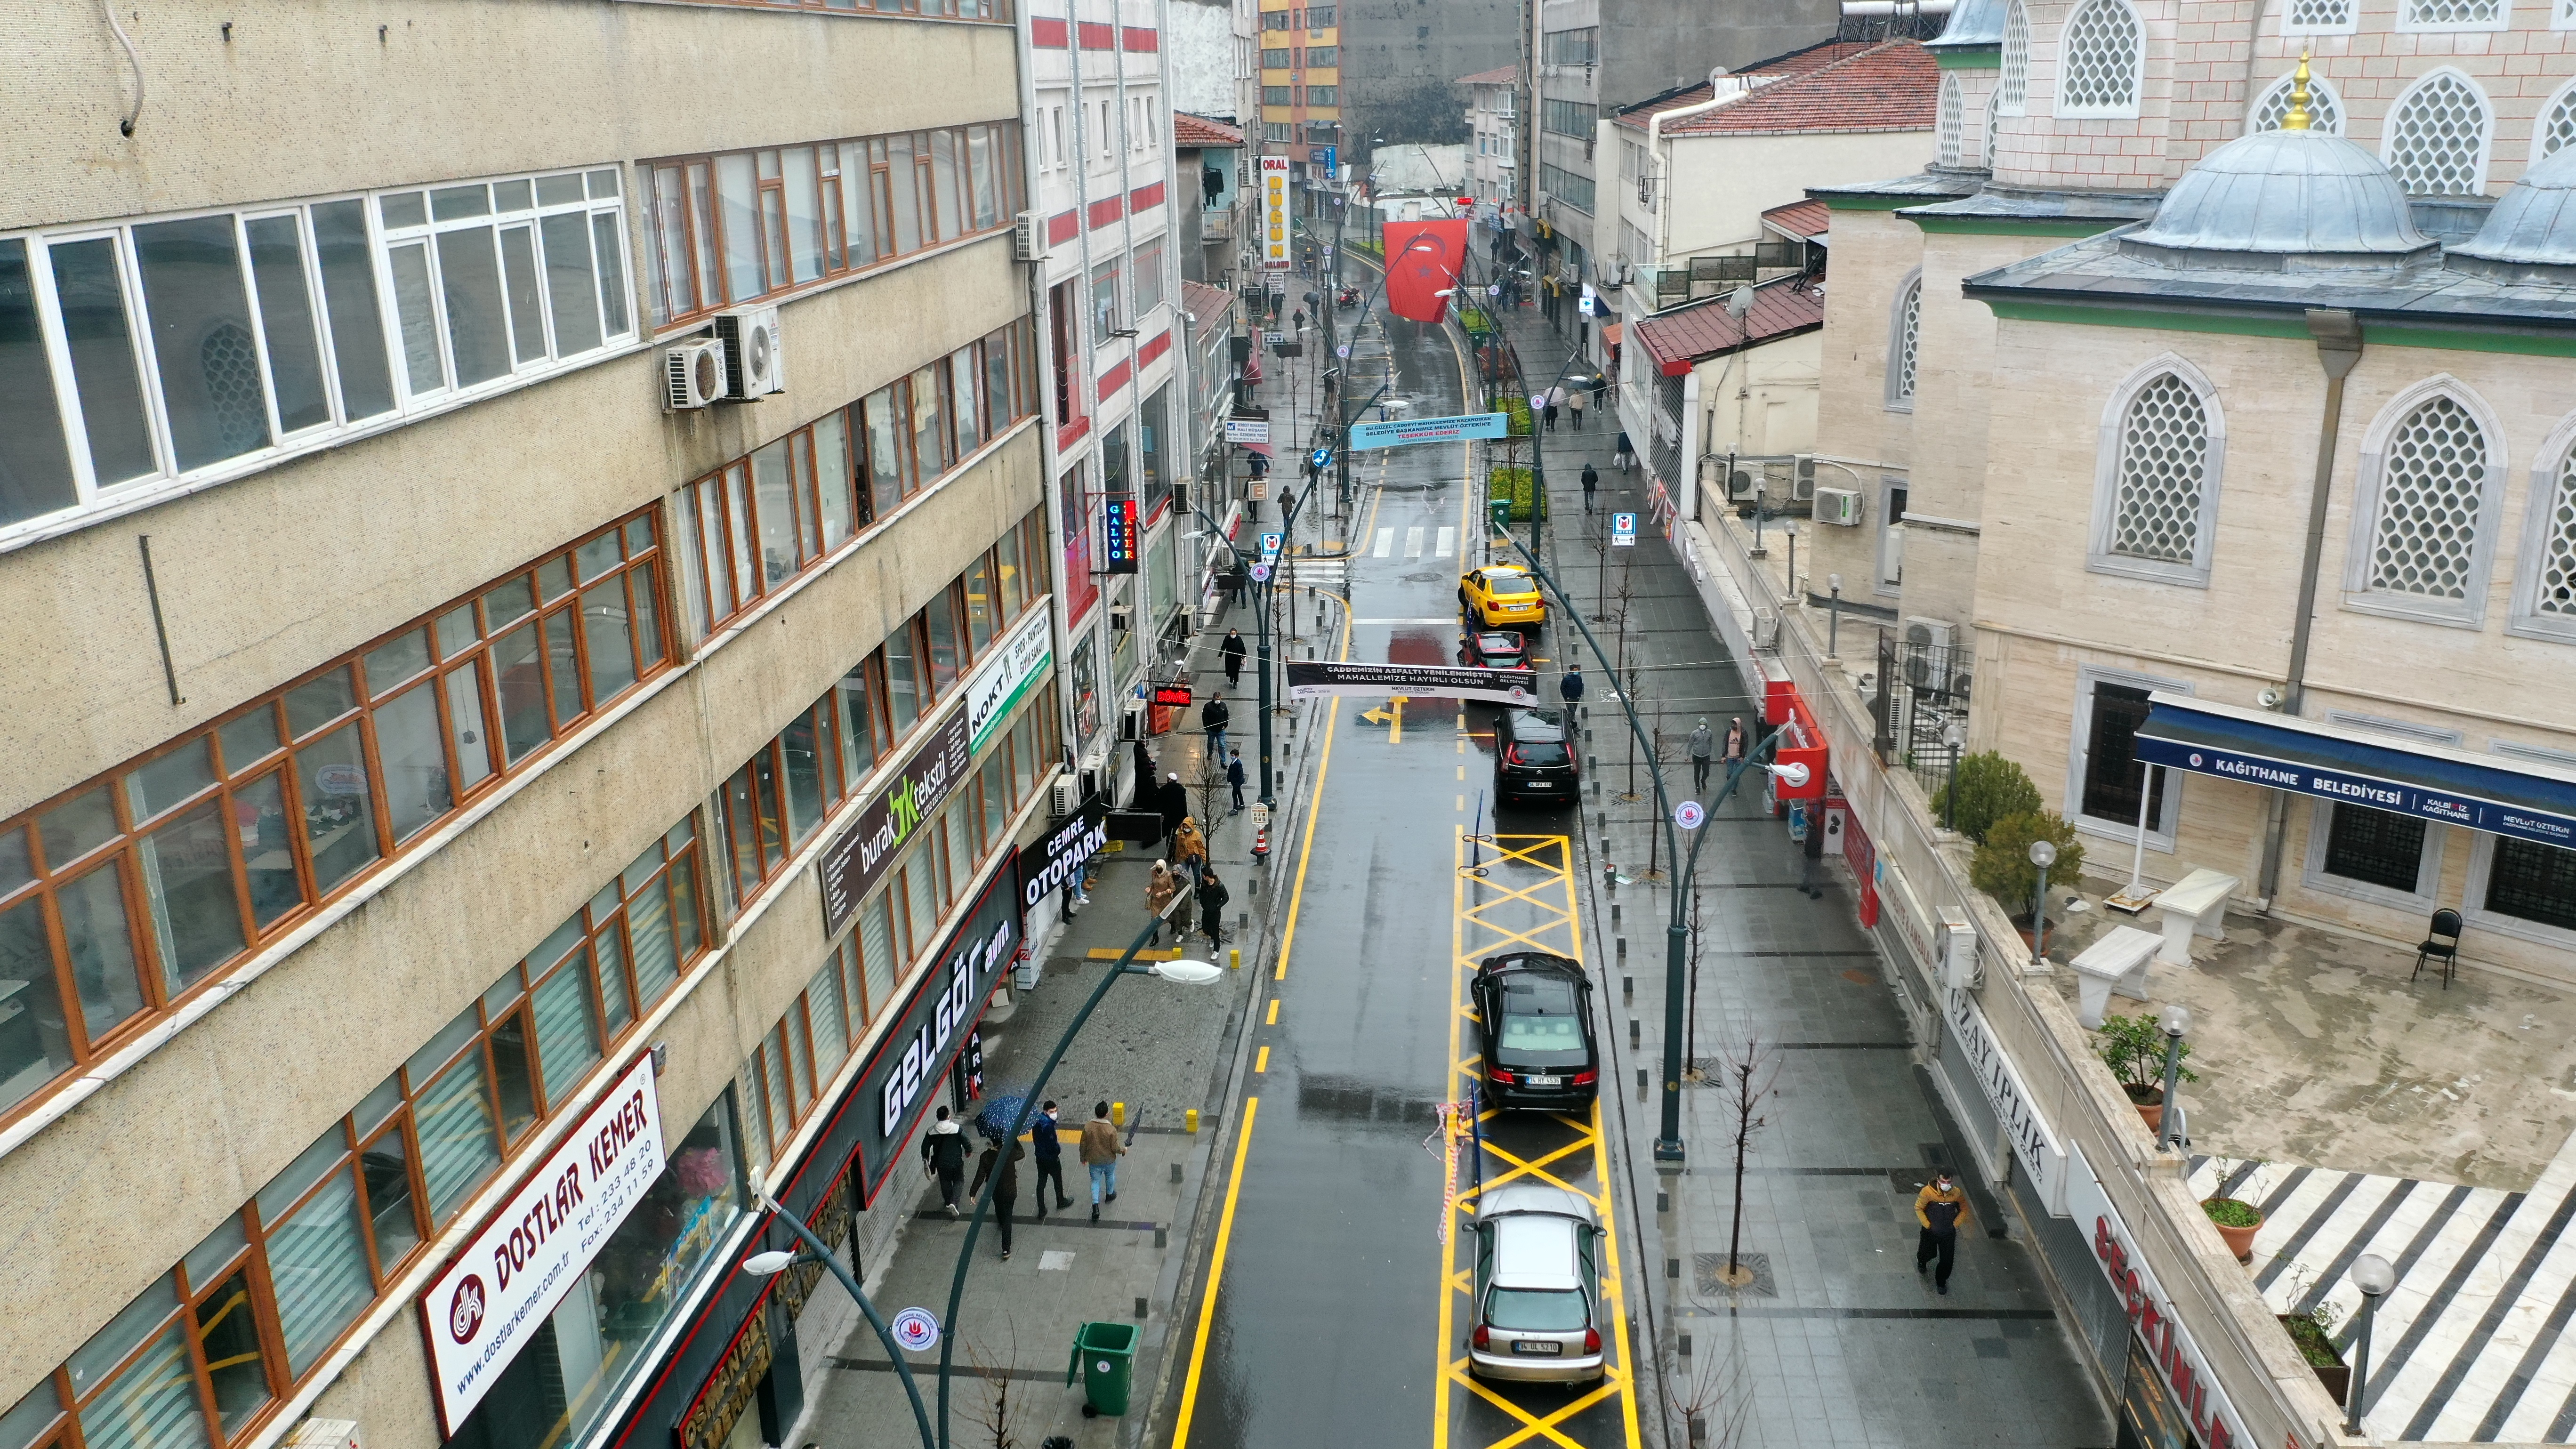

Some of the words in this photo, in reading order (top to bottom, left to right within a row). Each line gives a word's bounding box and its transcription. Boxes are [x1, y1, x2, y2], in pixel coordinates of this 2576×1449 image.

[1263, 160, 1287, 170] ORAL
[1268, 176, 1283, 258] DÜĞÜN
[1110, 506, 1120, 558] GALVO
[1015, 637, 1025, 659] SPOR
[1028, 614, 1047, 646] PANTOLON
[1020, 653, 1030, 675] GİYİM
[1031, 634, 1045, 660] SANAYİ
[1157, 690, 1189, 703] DÖVİZ
[1423, 669, 1492, 678] YENİLENMİŞTİR
[914, 751, 946, 810] tekstil
[2216, 758, 2298, 786] KAĞITHANE
[2313, 777, 2401, 805] BELEDİYESİ
[1047, 815, 1084, 857] CEMRE
[2423, 805, 2470, 820] KAĞITHANE
[861, 813, 896, 875] burak
[1027, 820, 1107, 905] OTOPARK
[985, 919, 1009, 973] avm
[1951, 988, 1991, 1070] UZAY
[1992, 1056, 2046, 1173] İPLİK
[495, 1162, 583, 1293] DOSTLAR
[588, 1088, 647, 1183] KEMER
[601, 1175, 621, 1206] 233
[624, 1157, 636, 1177] 48
[639, 1140, 651, 1160] 20
[580, 1223, 604, 1254] Fax:
[604, 1198, 624, 1228] 234
[626, 1178, 638, 1197] 11
[640, 1159, 653, 1179] 59
[457, 1251, 570, 1395] www.dostlarkemer.com.tr
[685, 1302, 766, 1449] OSMANBEY
